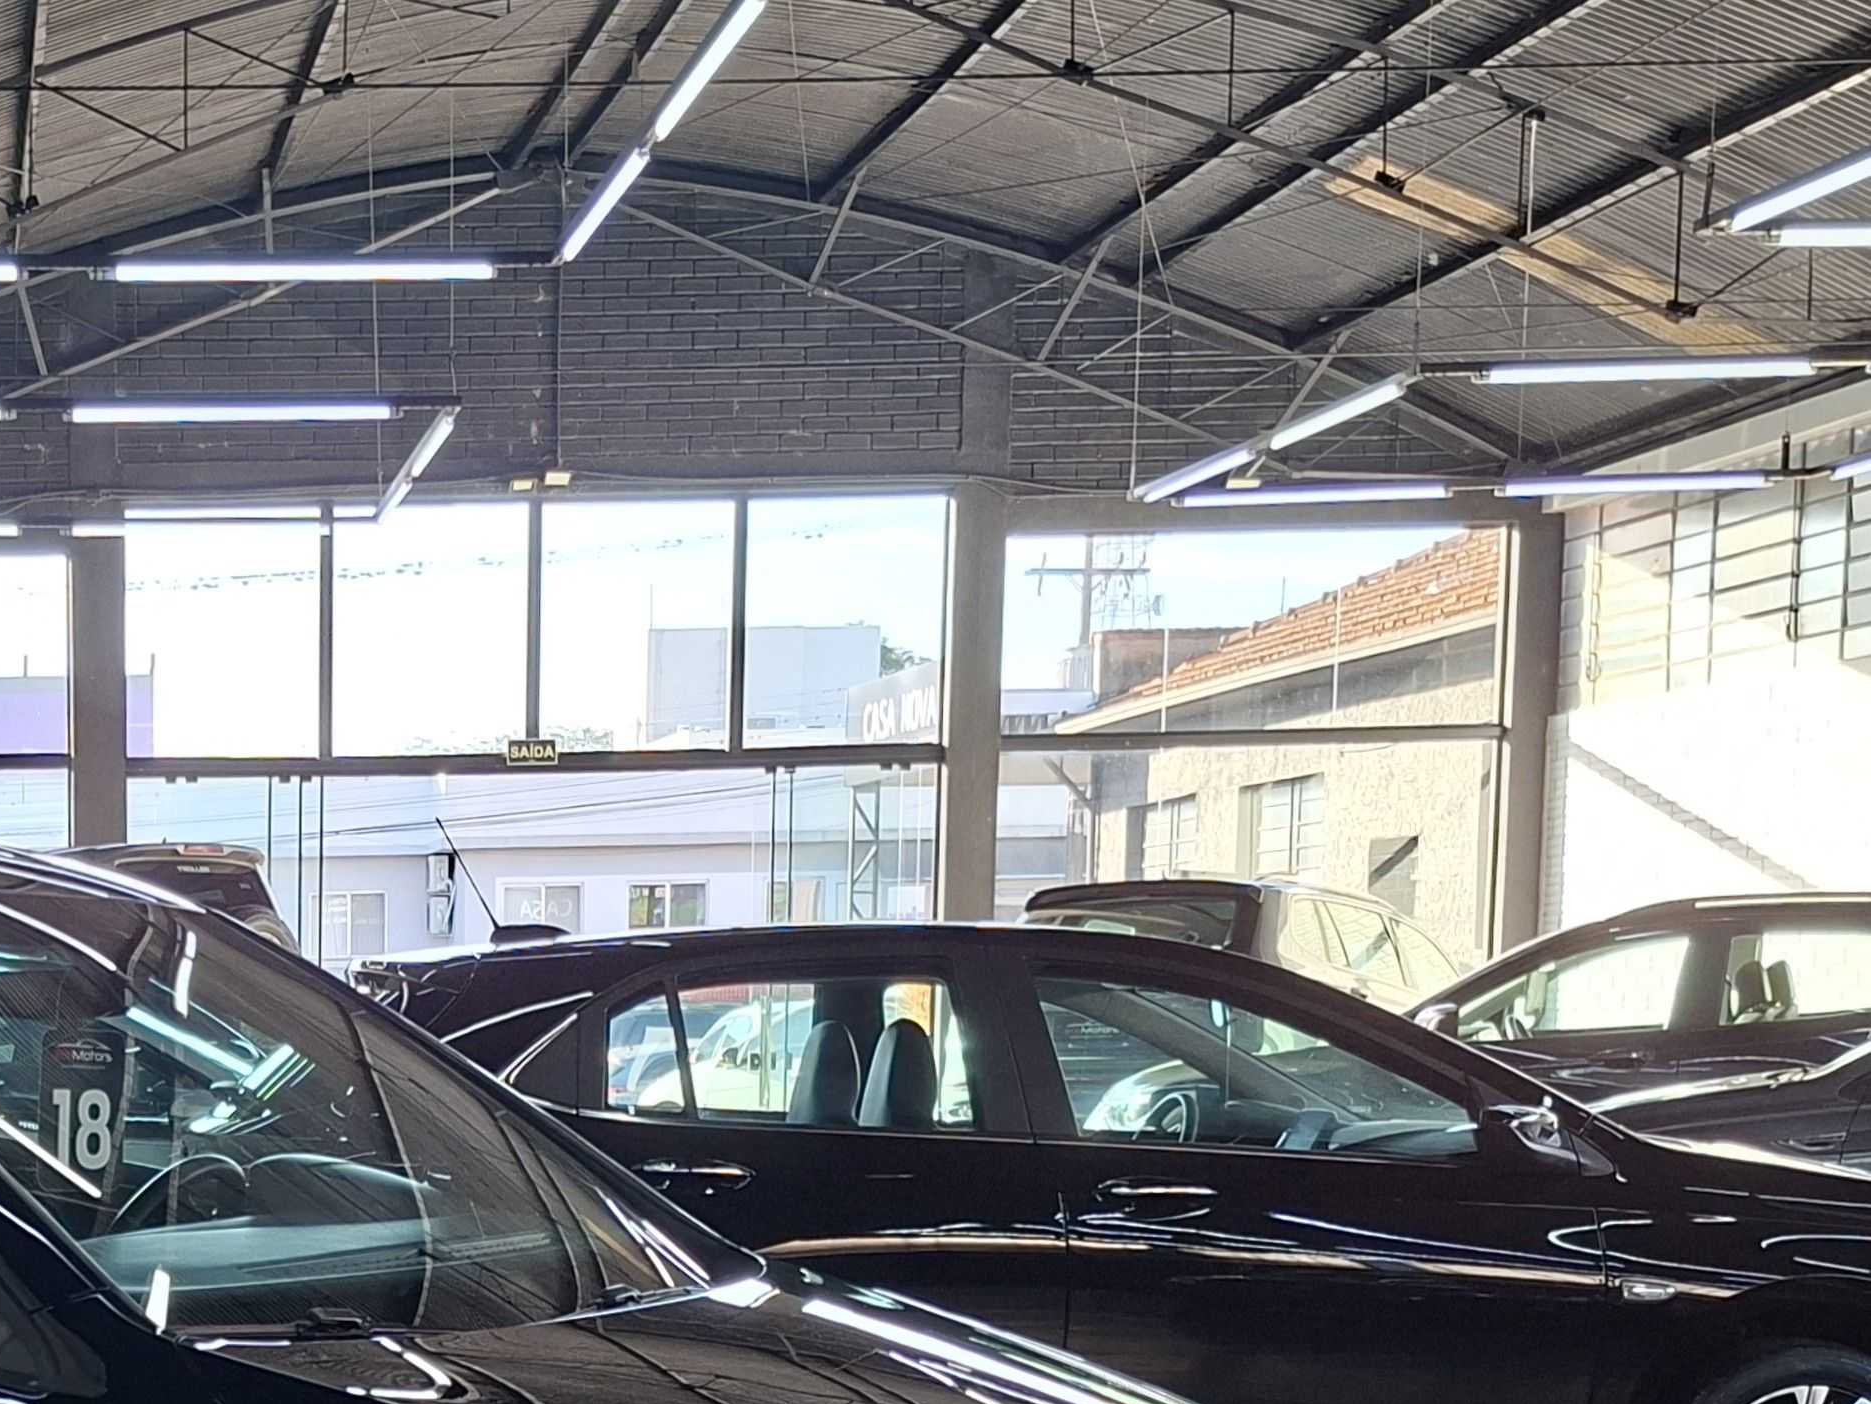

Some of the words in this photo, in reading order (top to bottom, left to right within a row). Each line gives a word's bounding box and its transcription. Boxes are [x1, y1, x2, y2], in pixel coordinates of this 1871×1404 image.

[862, 697, 896, 743] CASA
[900, 684, 938, 733] NOVA
[510, 742, 555, 759] SAÍDA
[72, 1049, 113, 1063] Motors
[51, 1087, 112, 1171] 18
